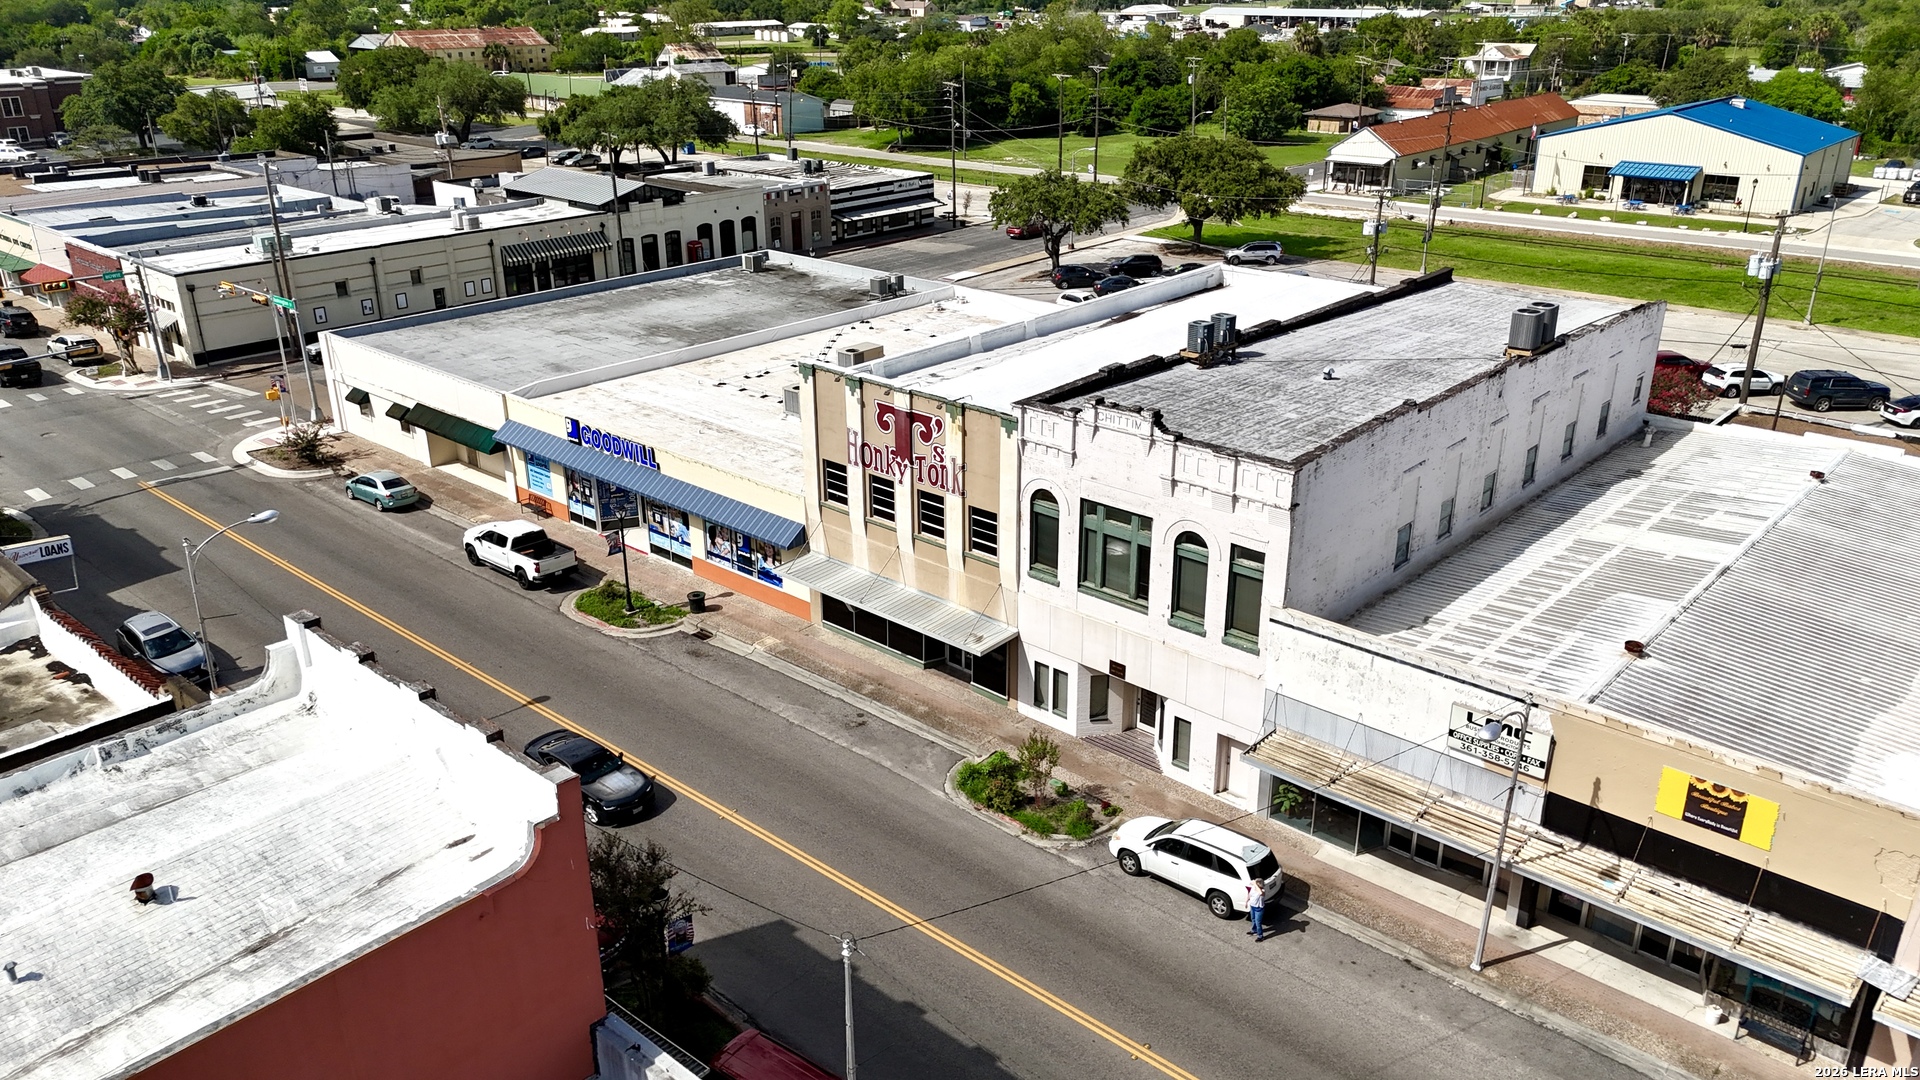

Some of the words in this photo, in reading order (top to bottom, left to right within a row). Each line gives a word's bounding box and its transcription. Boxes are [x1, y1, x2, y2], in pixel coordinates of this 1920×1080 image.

[1098, 411, 1141, 430] CHITTIM
[581, 425, 657, 469] GOODWILL
[847, 427, 908, 485] Honky
[914, 454, 965, 497] Tonk
[40, 542, 69, 558] LOANS
[1452, 731, 1472, 745] OFFICE
[1473, 738, 1500, 753] SUPPLIES
[1504, 749, 1519, 760] COP
[1526, 757, 1541, 767] FAX
[1500, 736, 1531, 750] RODUTS
[1691, 791, 1721, 804] Beautiful
[1700, 803, 1728, 816] Boutique
